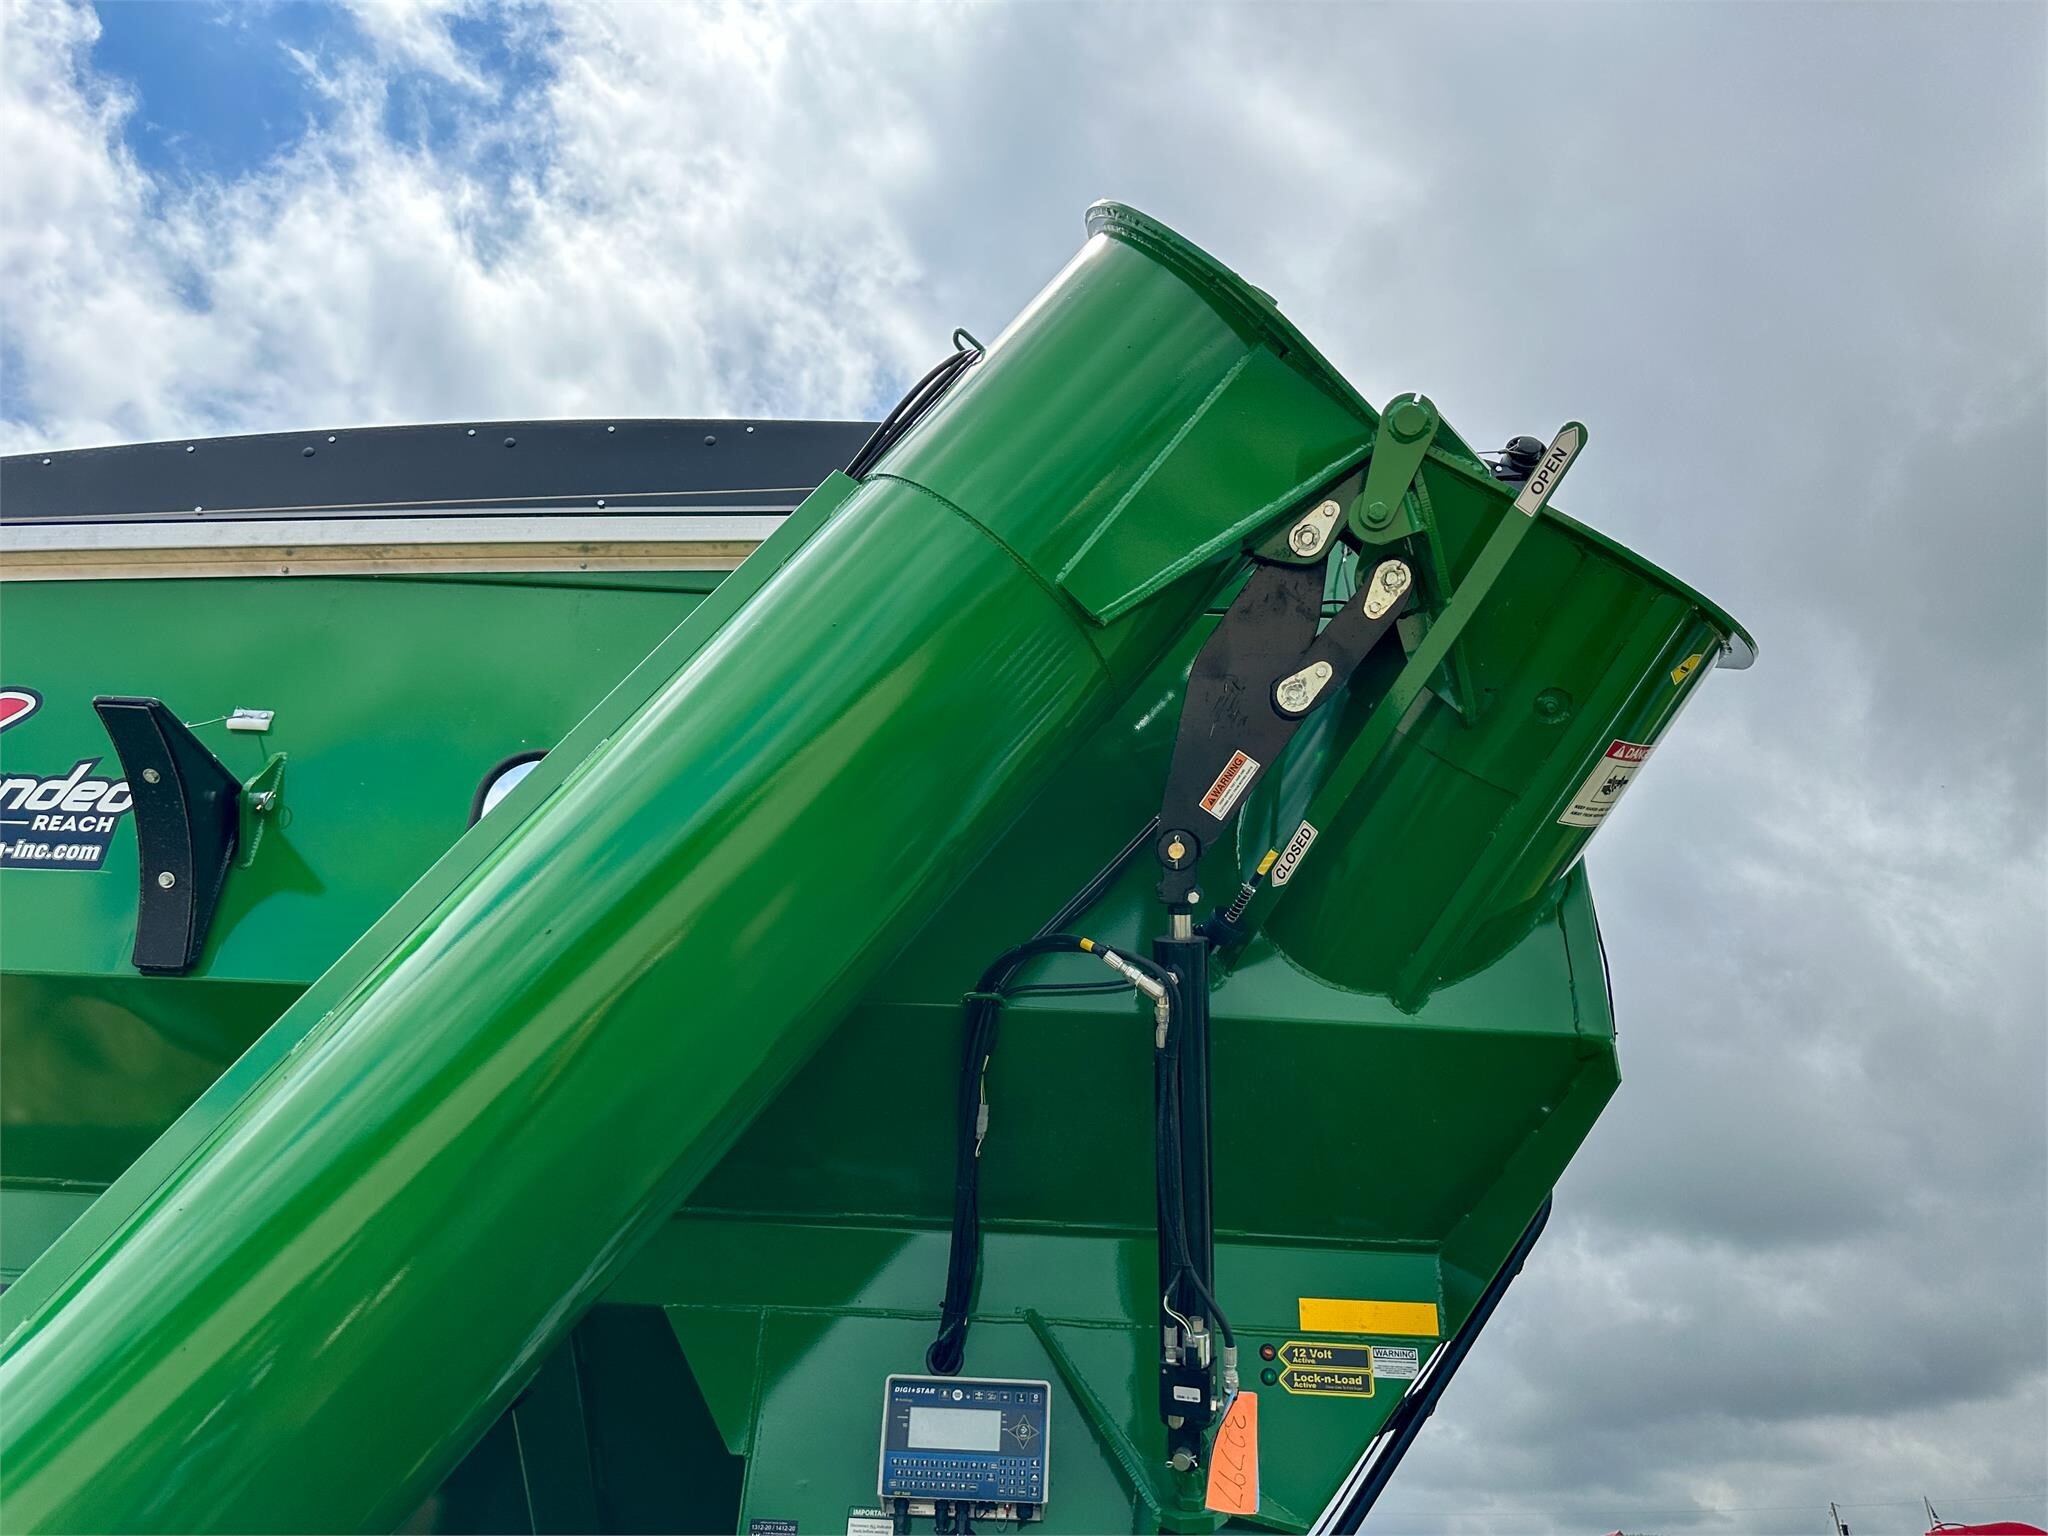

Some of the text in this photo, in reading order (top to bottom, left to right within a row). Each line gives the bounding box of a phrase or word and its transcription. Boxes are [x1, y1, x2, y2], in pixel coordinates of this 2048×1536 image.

[1530, 446, 1568, 495] OPEN
[1211, 756, 1244, 798] WARNING
[31, 814, 115, 833] REACH
[1275, 827, 1312, 880] CLOSED
[1292, 1348, 1333, 1359] 12 Volt
[1375, 1349, 1415, 1359] WARNING
[1293, 1372, 1363, 1385] Lock-n-Load
